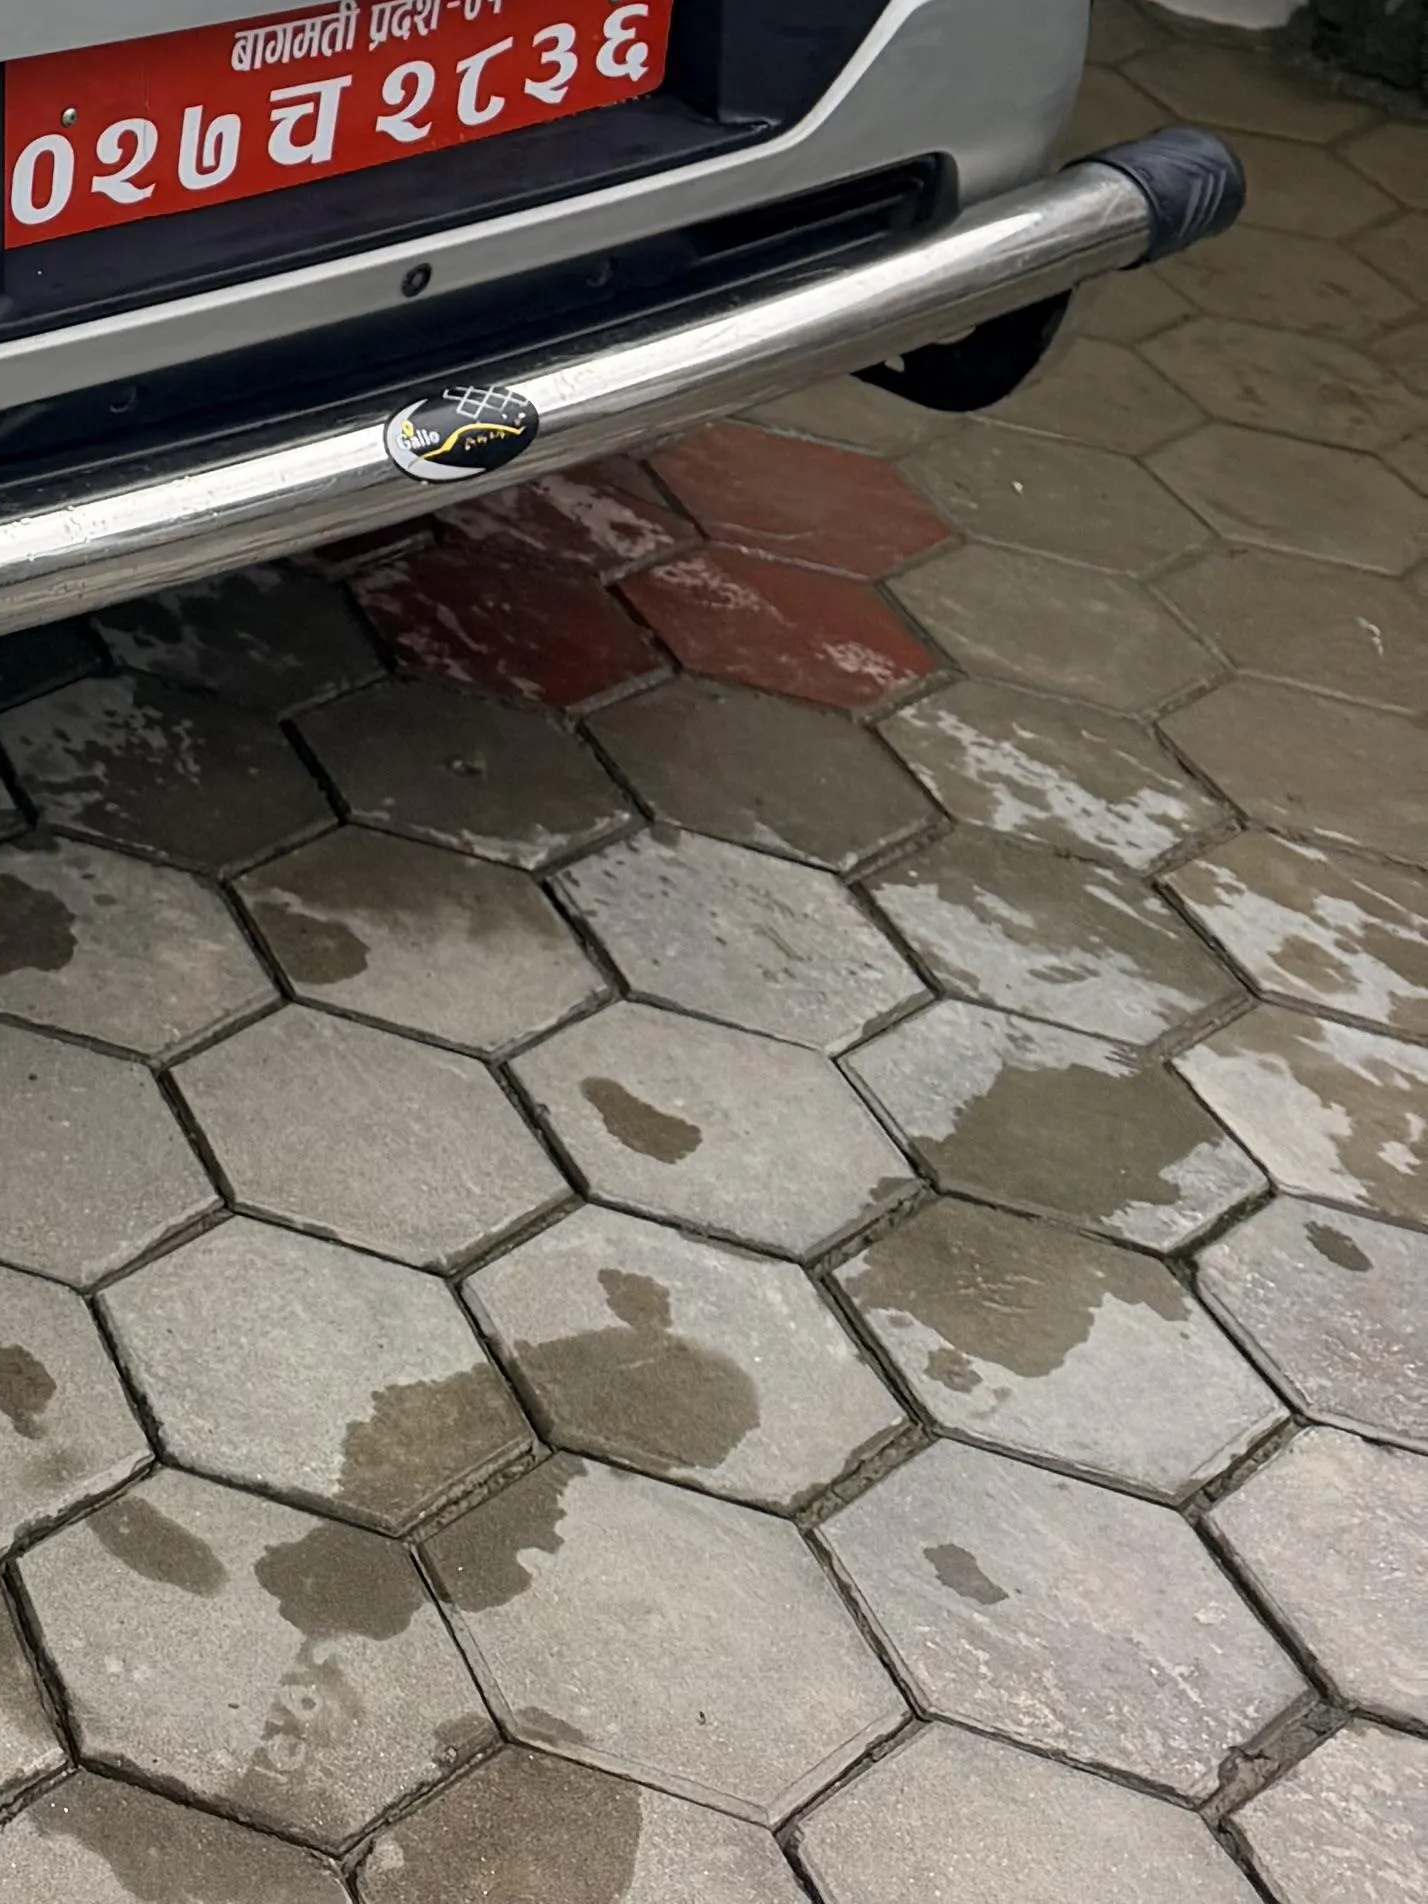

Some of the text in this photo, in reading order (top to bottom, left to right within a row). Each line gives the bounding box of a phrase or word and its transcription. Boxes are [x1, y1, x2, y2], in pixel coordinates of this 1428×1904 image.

[231, 0, 358, 72] बागमती
[10, 3, 649, 225] ०२७ च २८३६
[397, 428, 440, 450] Gallo
